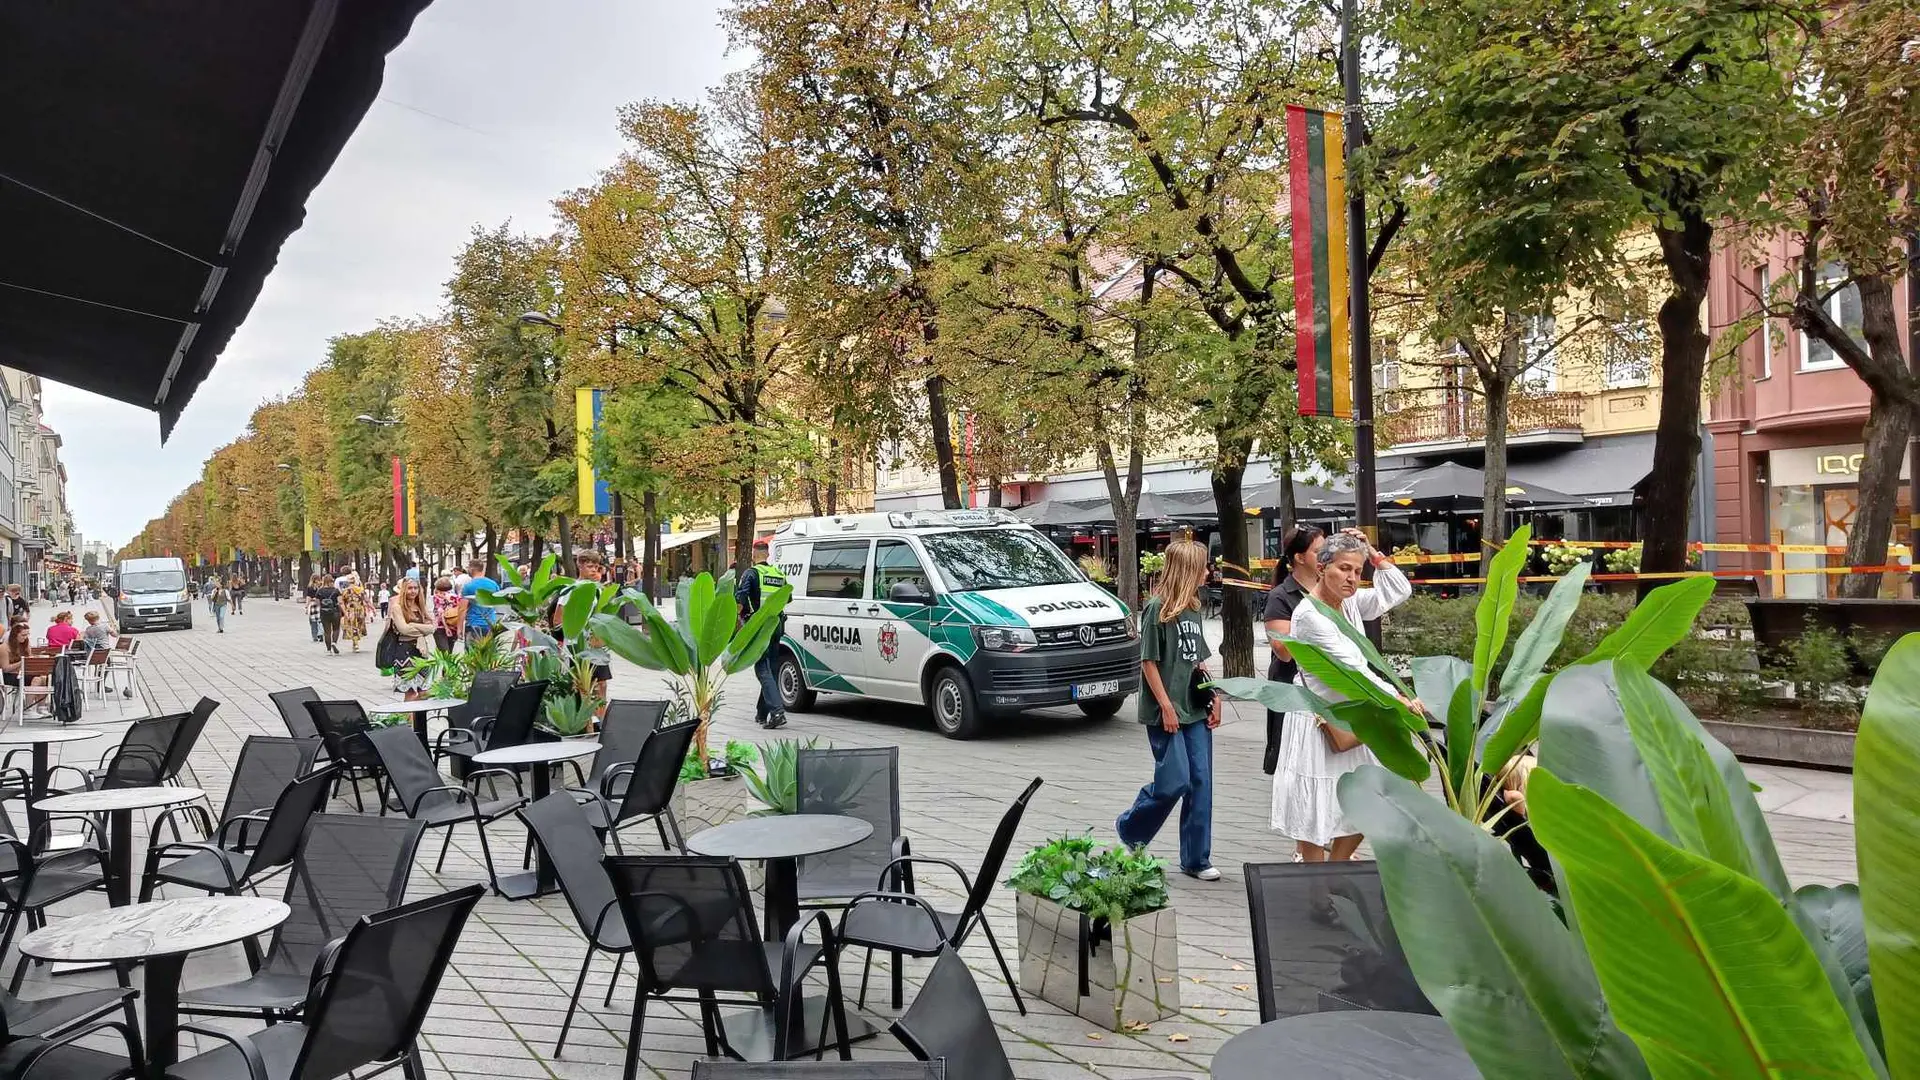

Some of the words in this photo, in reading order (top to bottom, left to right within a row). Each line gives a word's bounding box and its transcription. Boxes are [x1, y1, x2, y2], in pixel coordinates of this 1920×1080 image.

[1817, 454, 1864, 475] IQO
[1025, 600, 1110, 615] POLICIJA
[803, 624, 862, 645] POLICIJA
[1078, 684, 1097, 696] KJP
[1102, 682, 1118, 692] 729
